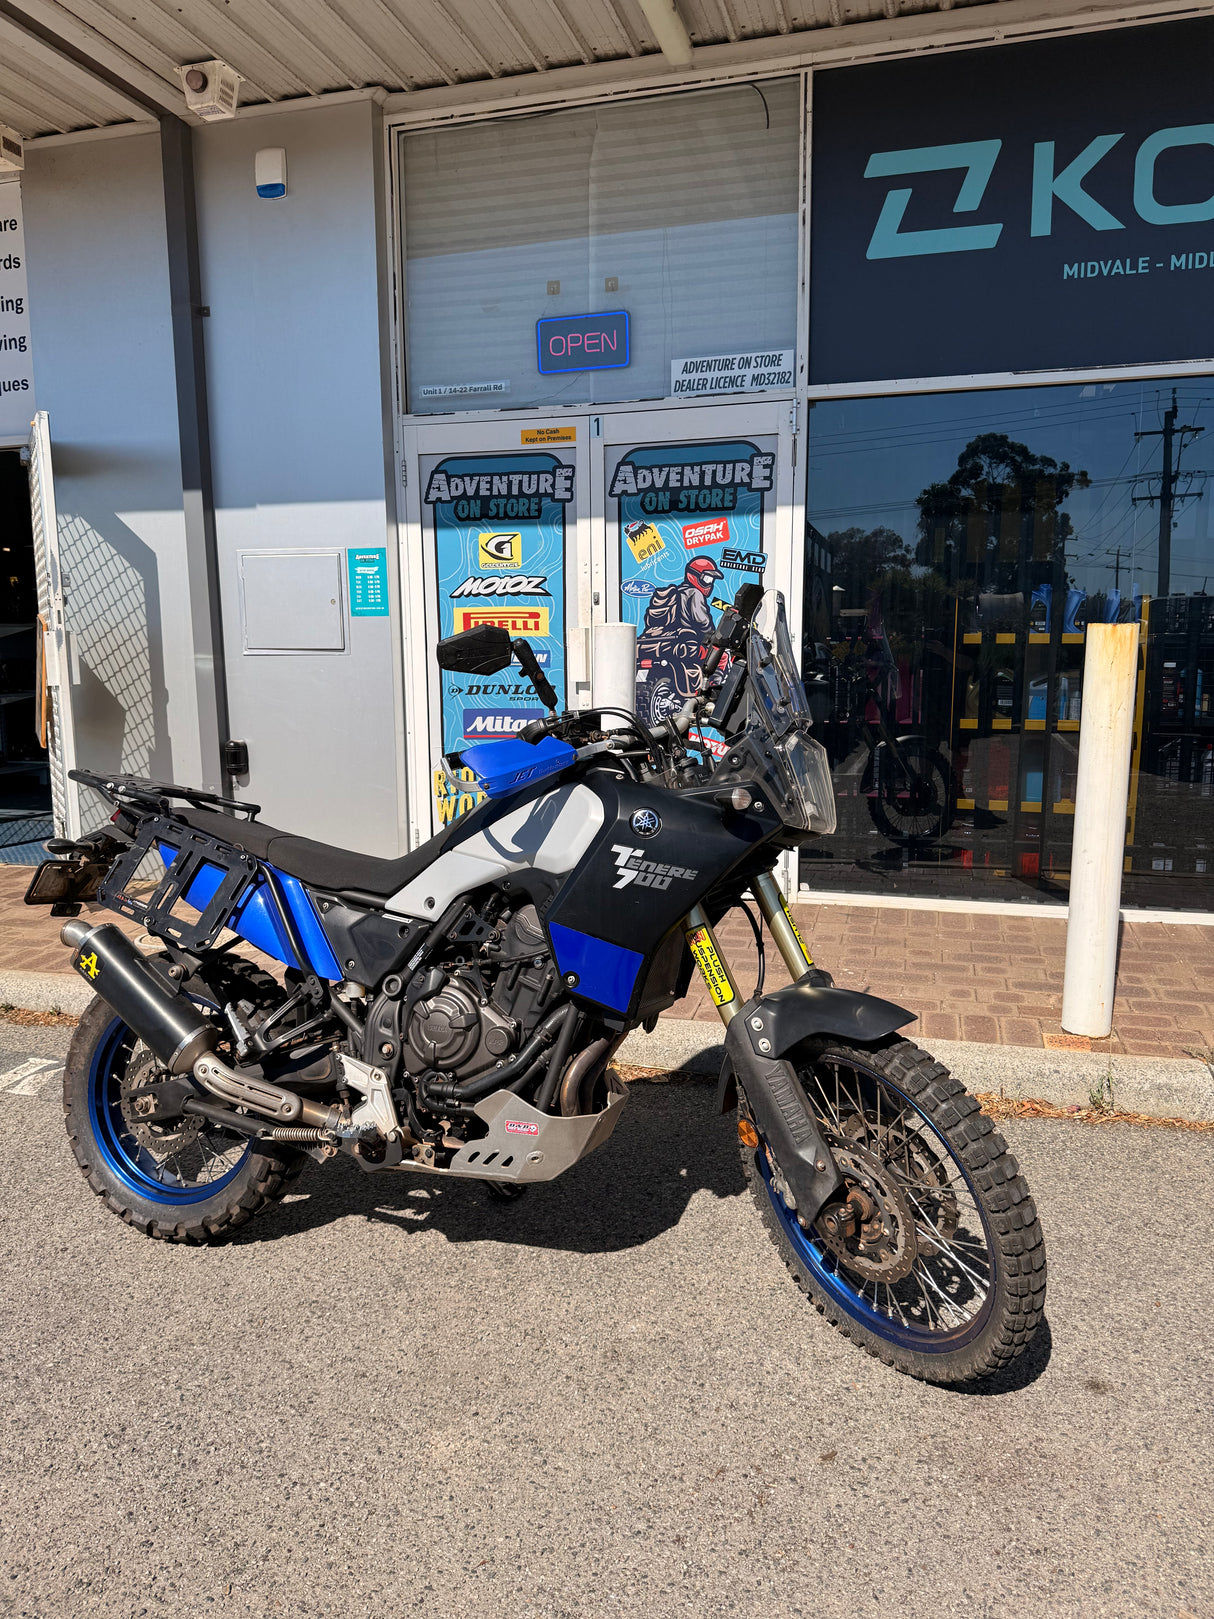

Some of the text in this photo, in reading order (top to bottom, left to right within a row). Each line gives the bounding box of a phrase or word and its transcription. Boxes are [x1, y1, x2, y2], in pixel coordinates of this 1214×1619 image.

[1064, 257, 1149, 279] MIDVALE
[550, 330, 616, 356] OPEN
[681, 354, 783, 375] ADVENTURE ON STORE
[423, 388, 437, 396] Unit
[449, 386, 468, 394] 14-22
[468, 384, 491, 393] Farrall
[673, 371, 792, 393] DEALER LICENCE MD32182
[593, 417, 600, 437] 1
[426, 468, 573, 501] ADVENTURE
[612, 456, 773, 494] ADVENTURE
[457, 498, 539, 518] ON STORE
[643, 488, 734, 511] ON STORE
[685, 521, 724, 538] OSAH
[687, 531, 724, 546] DRYPAK
[638, 536, 662, 561] eni
[723, 549, 766, 565] EMD
[465, 684, 556, 695] DUNLO
[509, 767, 537, 784] JET
[612, 868, 673, 890] 700
[706, 945, 726, 983] PLUSH
[765, 1063, 813, 1145] YAMAHA
